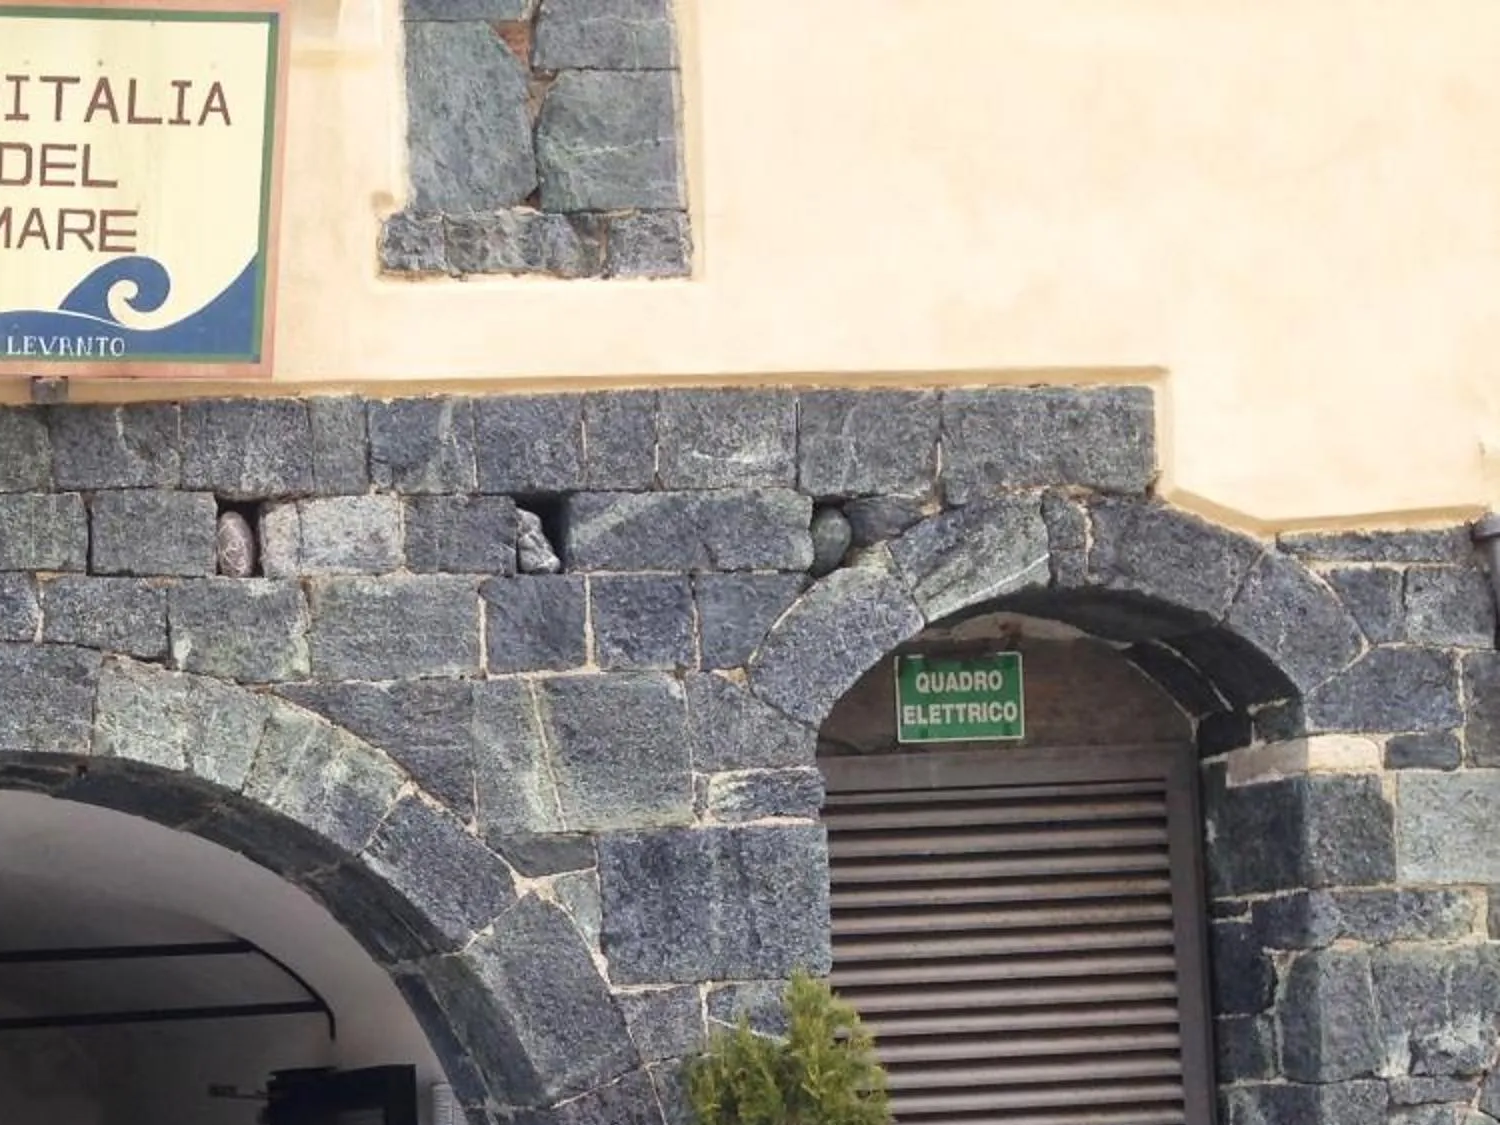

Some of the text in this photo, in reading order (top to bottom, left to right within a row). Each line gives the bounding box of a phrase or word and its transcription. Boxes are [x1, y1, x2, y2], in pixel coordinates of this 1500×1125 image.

[7, 336, 126, 357] LEVANTO
[915, 670, 1003, 693] QUADRO
[903, 701, 1018, 725] ELETTRICO
